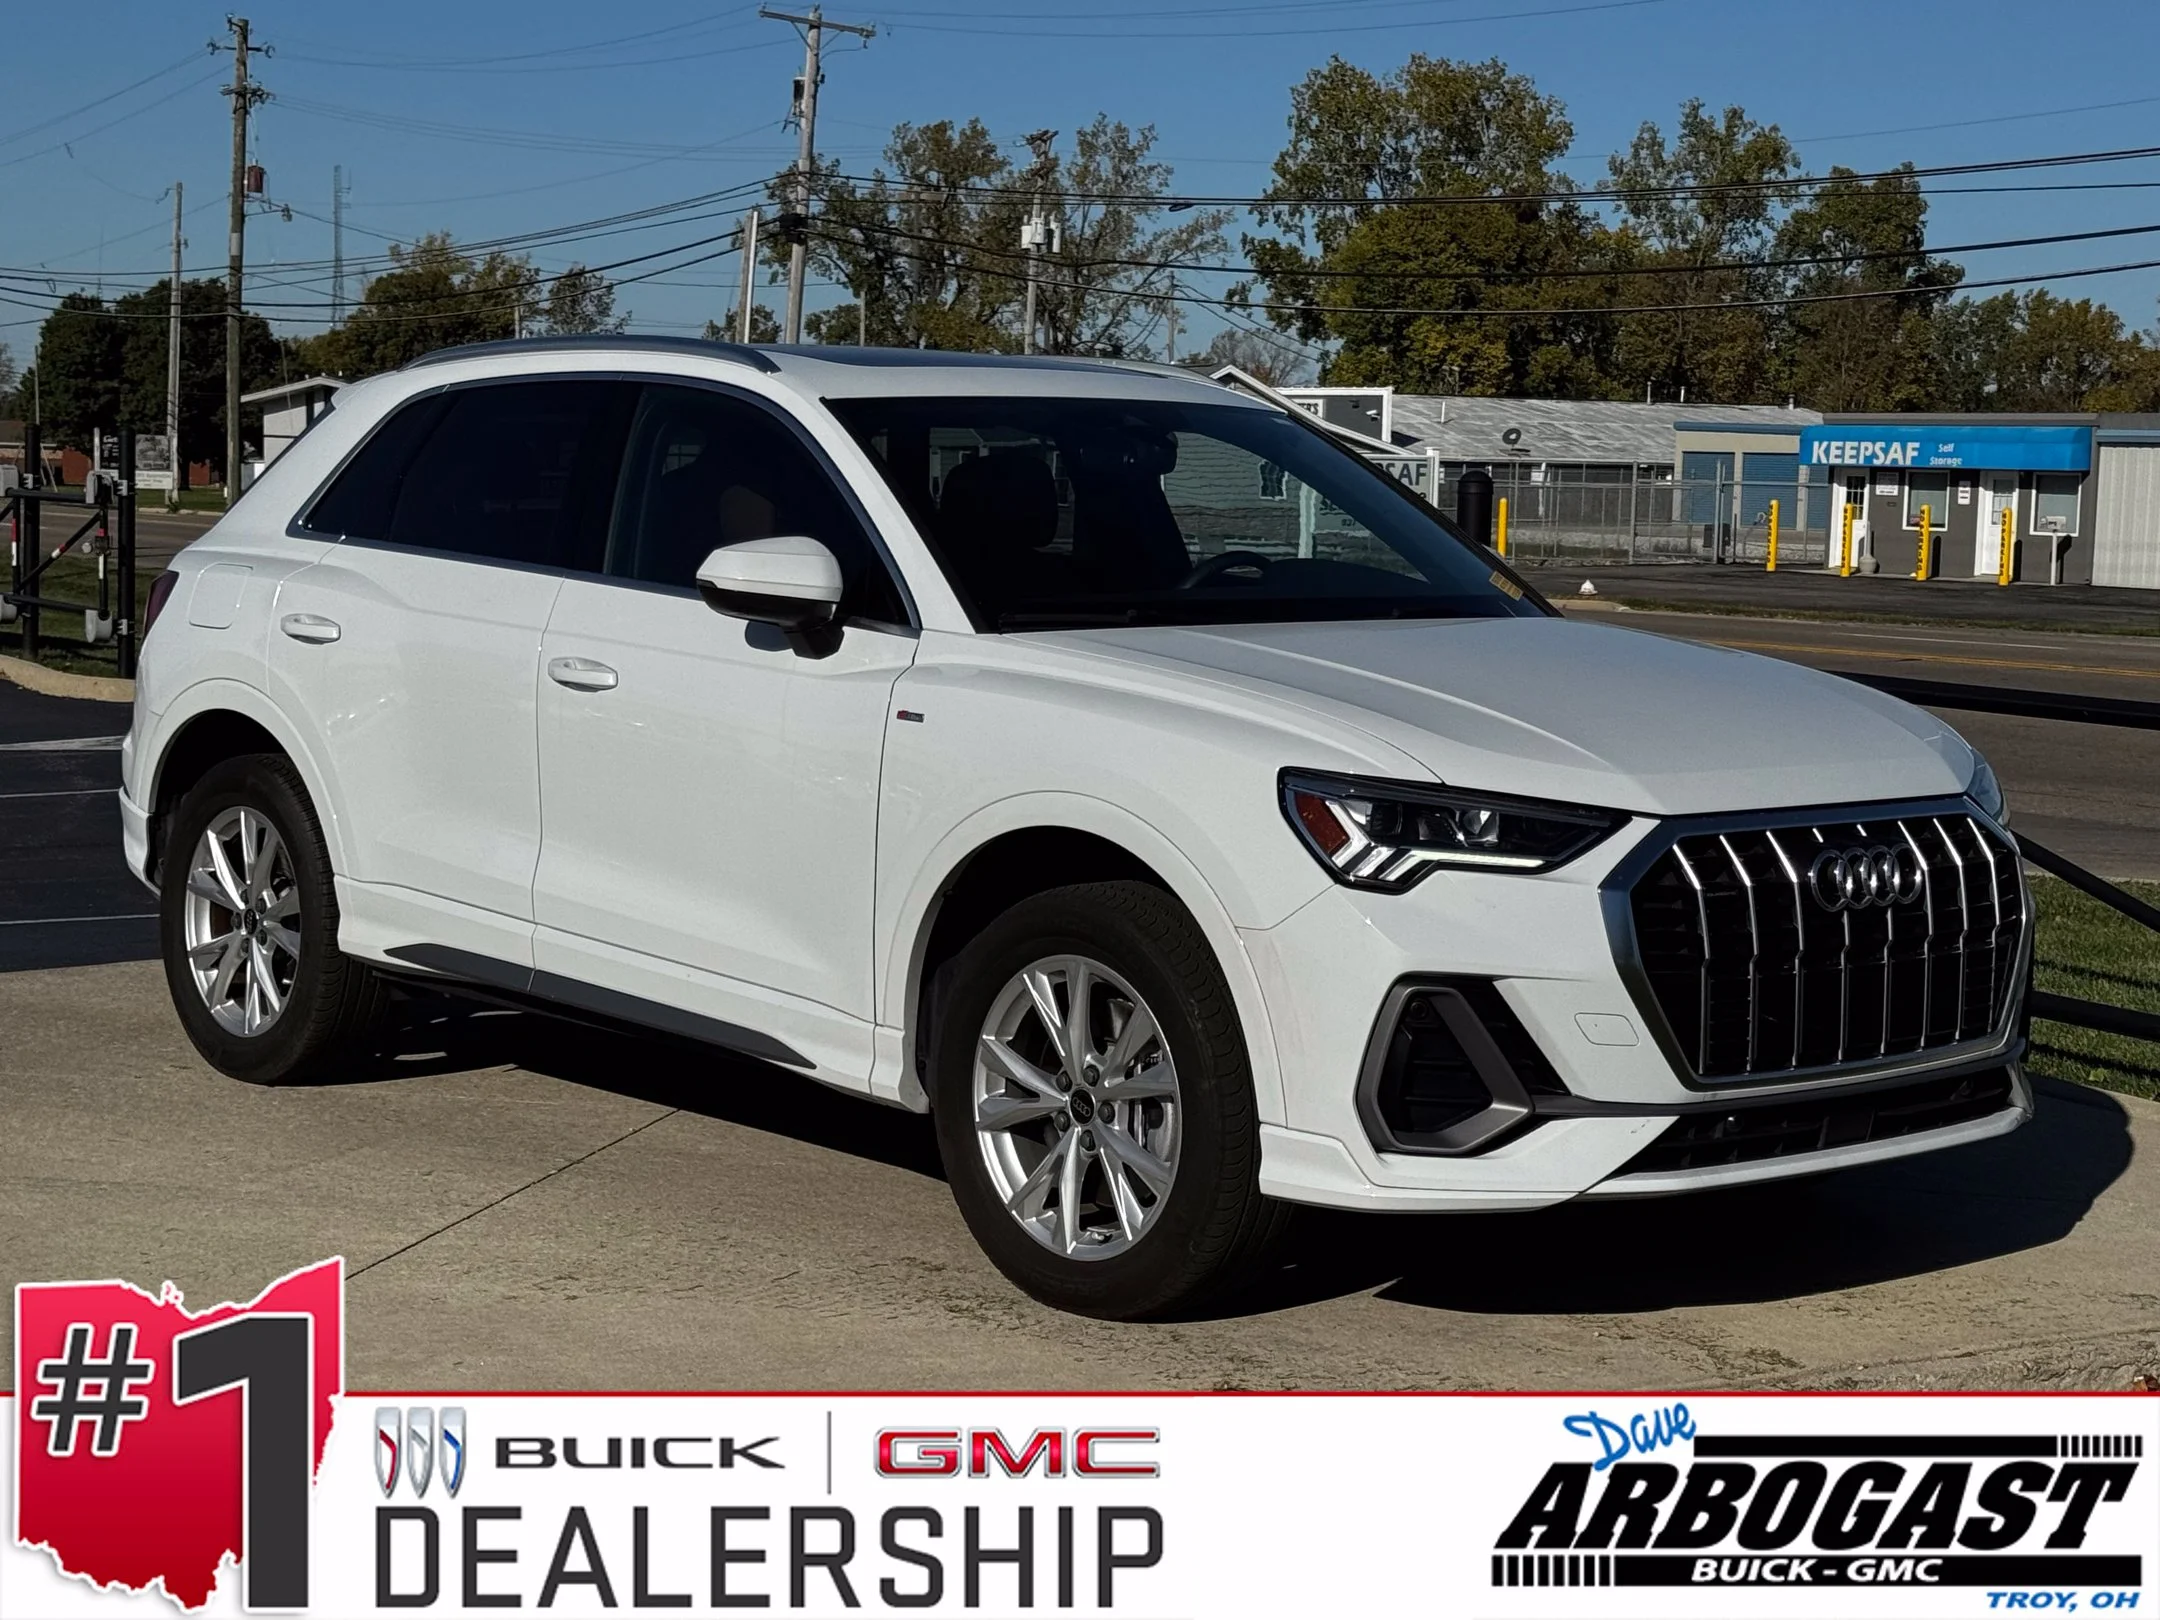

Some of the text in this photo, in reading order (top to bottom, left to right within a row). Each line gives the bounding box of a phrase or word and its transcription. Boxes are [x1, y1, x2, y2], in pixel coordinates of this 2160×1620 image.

[1812, 440, 1920, 465] KEEPSAF
[1938, 443, 1955, 453] Self
[1929, 456, 1963, 466] Storage
